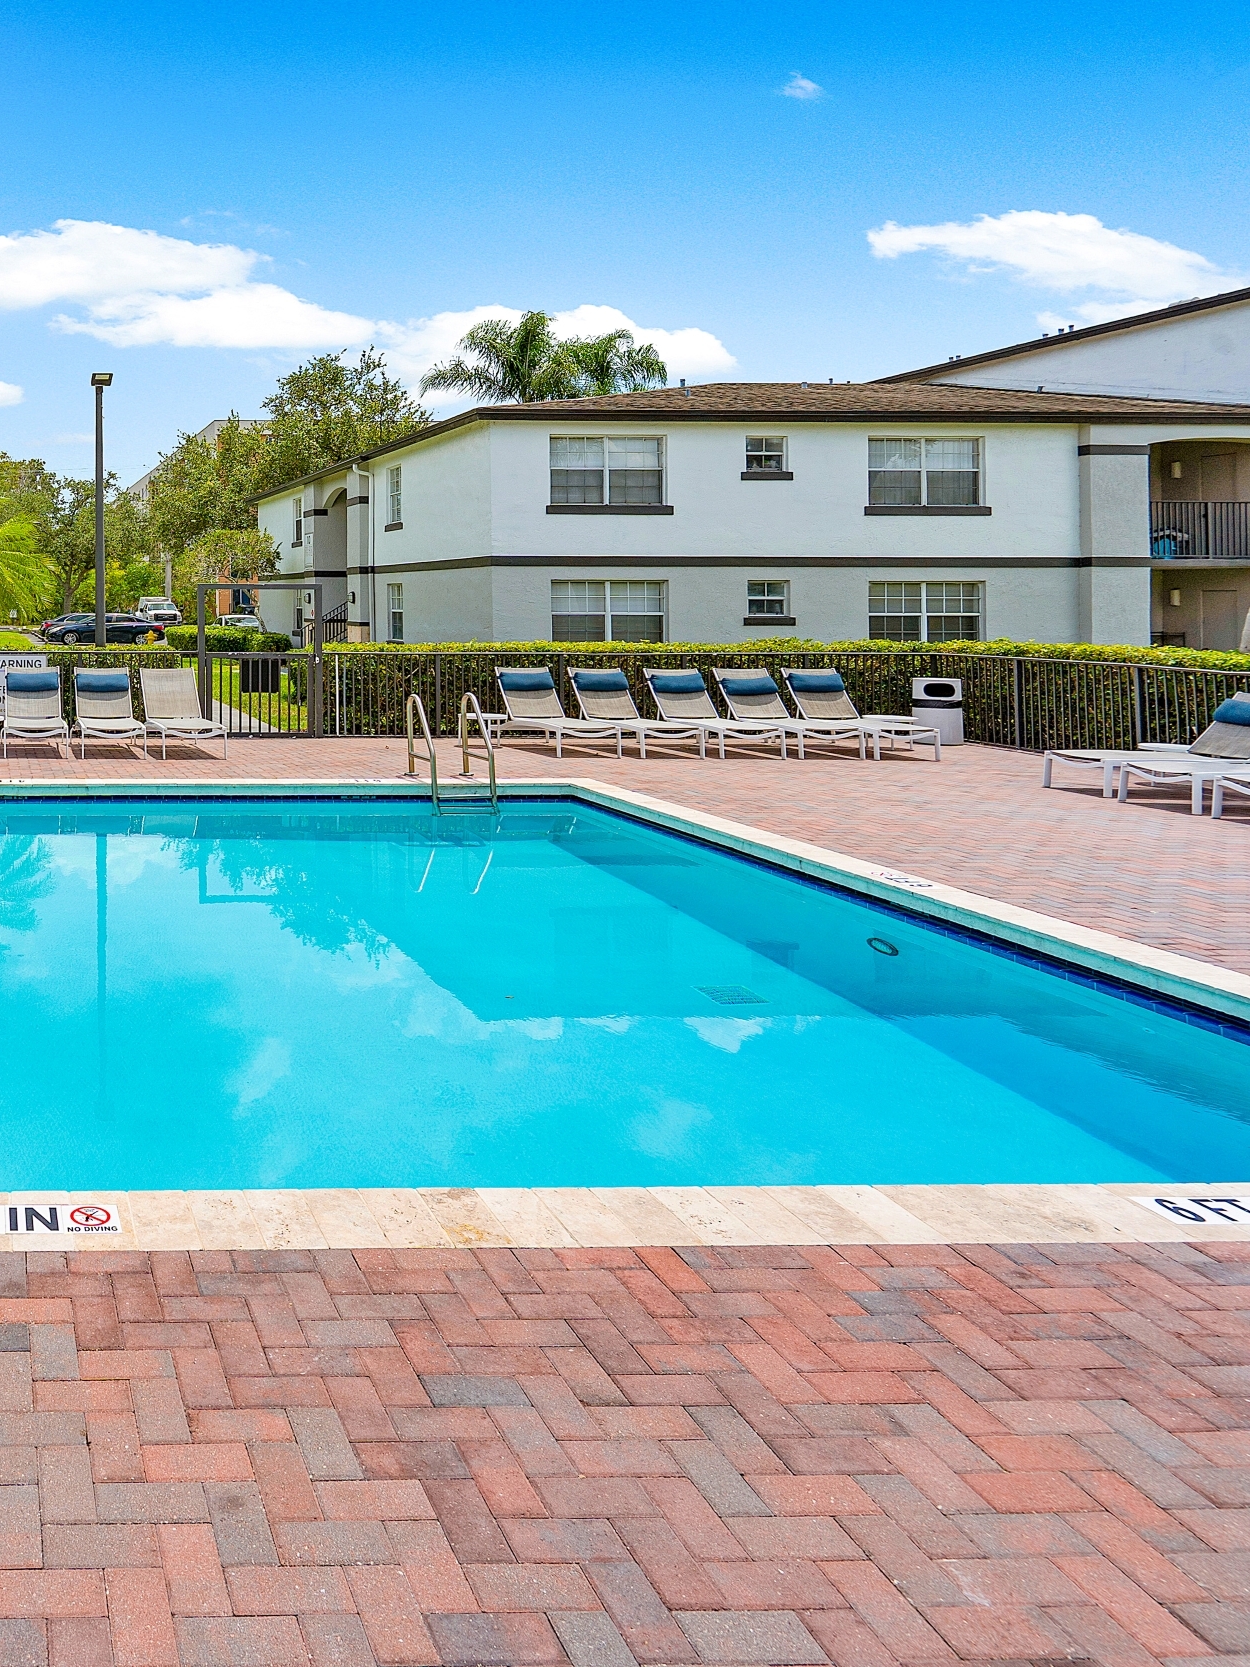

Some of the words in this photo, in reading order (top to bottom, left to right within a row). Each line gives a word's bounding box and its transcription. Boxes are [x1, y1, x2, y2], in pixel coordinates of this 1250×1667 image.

[8, 1206, 60, 1232] IN
[1154, 1198, 1206, 1223] 6
[1187, 1198, 1250, 1222] FT
[83, 1225, 118, 1233] DIVING
